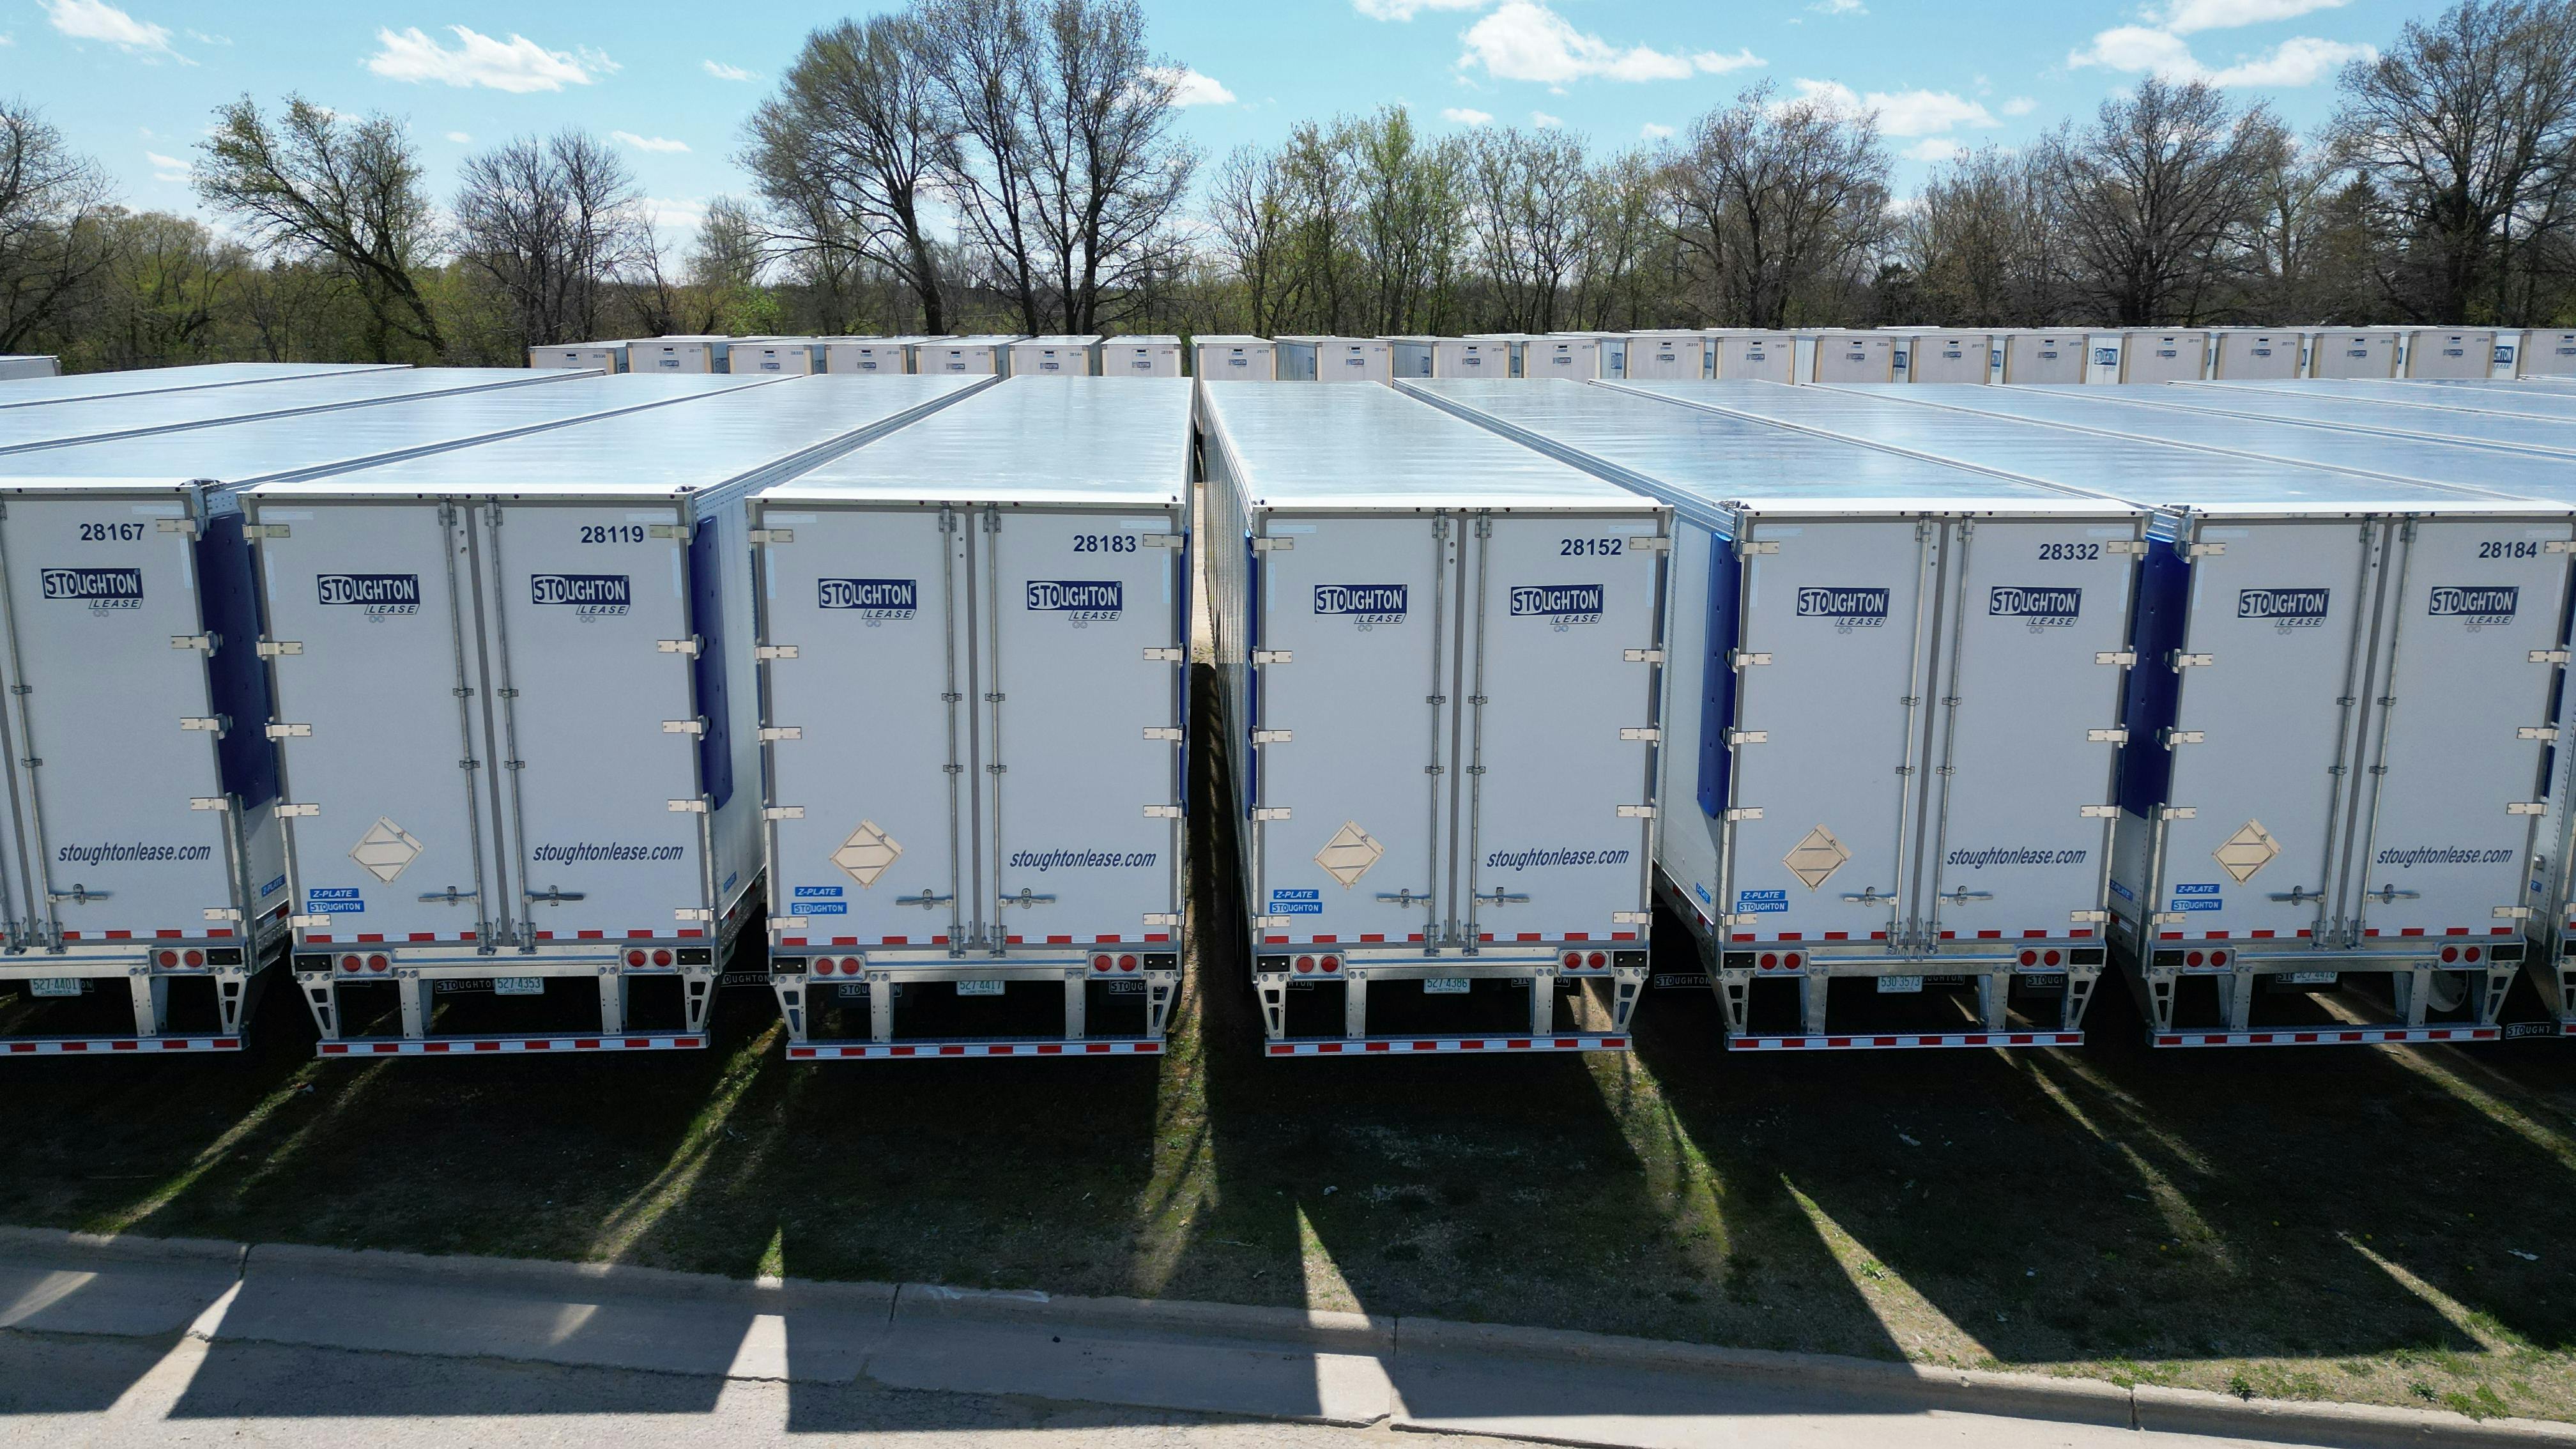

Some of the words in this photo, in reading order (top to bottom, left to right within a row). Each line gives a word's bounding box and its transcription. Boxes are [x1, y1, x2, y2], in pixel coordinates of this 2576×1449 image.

[80, 523, 144, 542] 28167
[580, 526, 644, 544] 28119
[1073, 535, 1137, 553] 28183
[1560, 539, 1622, 556] 28152
[2479, 542, 2538, 558] 28184
[2039, 543, 2099, 560] 28332
[45, 572, 137, 596] STOUGHTON
[320, 578, 414, 602] STOUGHTON
[533, 578, 625, 602] STOUGHTON
[821, 582, 912, 606] STOUGHTON
[1029, 584, 1118, 608] STOUGHTON
[1317, 588, 1403, 611] STOUGHTON
[1514, 588, 1599, 611] STOUGHTON
[2432, 588, 2514, 613] STOUGHTON
[93, 599, 140, 609] LEASE
[1799, 590, 1885, 614] STOUGHTON
[1991, 589, 2077, 613] STOUGHTON
[2241, 592, 2325, 615] STOUGHTON
[369, 604, 417, 615] LEASE
[579, 605, 627, 614] LEASE
[866, 610, 912, 619] LEASE
[1073, 611, 1119, 620] LEASE
[1360, 615, 1402, 623] LEASE
[1554, 614, 1599, 624] LEASE
[1839, 617, 1883, 626] LEASE
[2031, 617, 2075, 625] LEASE
[2280, 618, 2323, 627] LEASE
[2469, 615, 2511, 624] LEASE
[58, 842, 211, 866] stoughtonlease.com
[533, 842, 684, 866] stoughtonlease.com
[1009, 848, 1156, 872] stoughtonlease.com
[1487, 848, 1629, 871] stoughtonlease.com
[1947, 847, 2087, 870] stoughtonlease.com
[2377, 845, 2513, 869] stoughtonlease.com
[1744, 891, 1780, 900] Z-PLATE
[2179, 885, 2215, 893] Z-PLATE
[310, 903, 361, 912] STOUGHTON
[794, 905, 843, 914] STOUGHTON
[1272, 903, 1320, 912] STOUGHTON
[1739, 902, 1786, 912] STOUGHTON
[2174, 901, 2220, 909] STOUGHTON
[724, 975, 769, 983] OUGHTON
[2028, 975, 2063, 985] STOUG
[841, 985, 900, 994] STOUN
[1111, 981, 1147, 991] STOUG
[2508, 1025, 2551, 1036] STOUGHT
